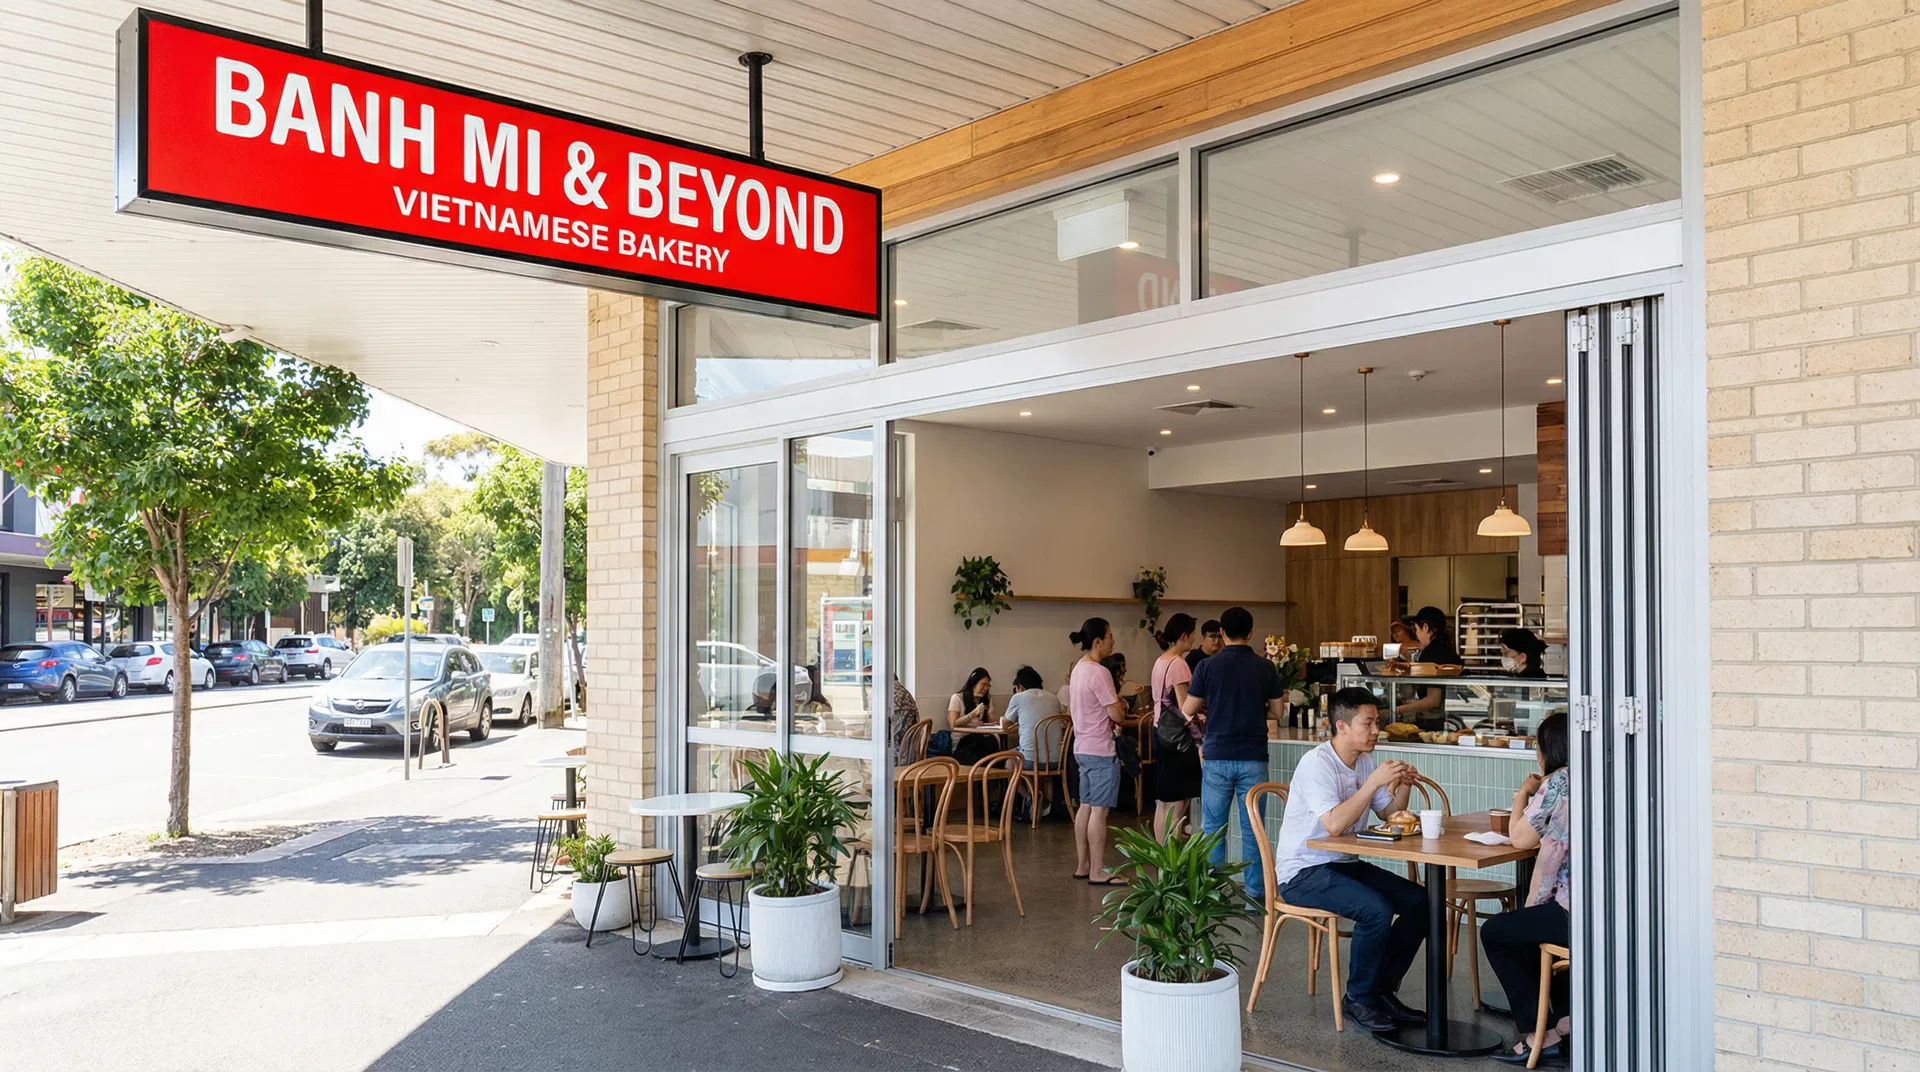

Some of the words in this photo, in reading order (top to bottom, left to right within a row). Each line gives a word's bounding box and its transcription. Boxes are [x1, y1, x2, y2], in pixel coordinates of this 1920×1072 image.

[215, 56, 436, 175] BANH
[463, 113, 541, 196] MI
[563, 141, 609, 210] &
[628, 151, 844, 255] BEYOND
[392, 185, 609, 252] VIETNAMESE
[618, 229, 730, 273] BAKERY
